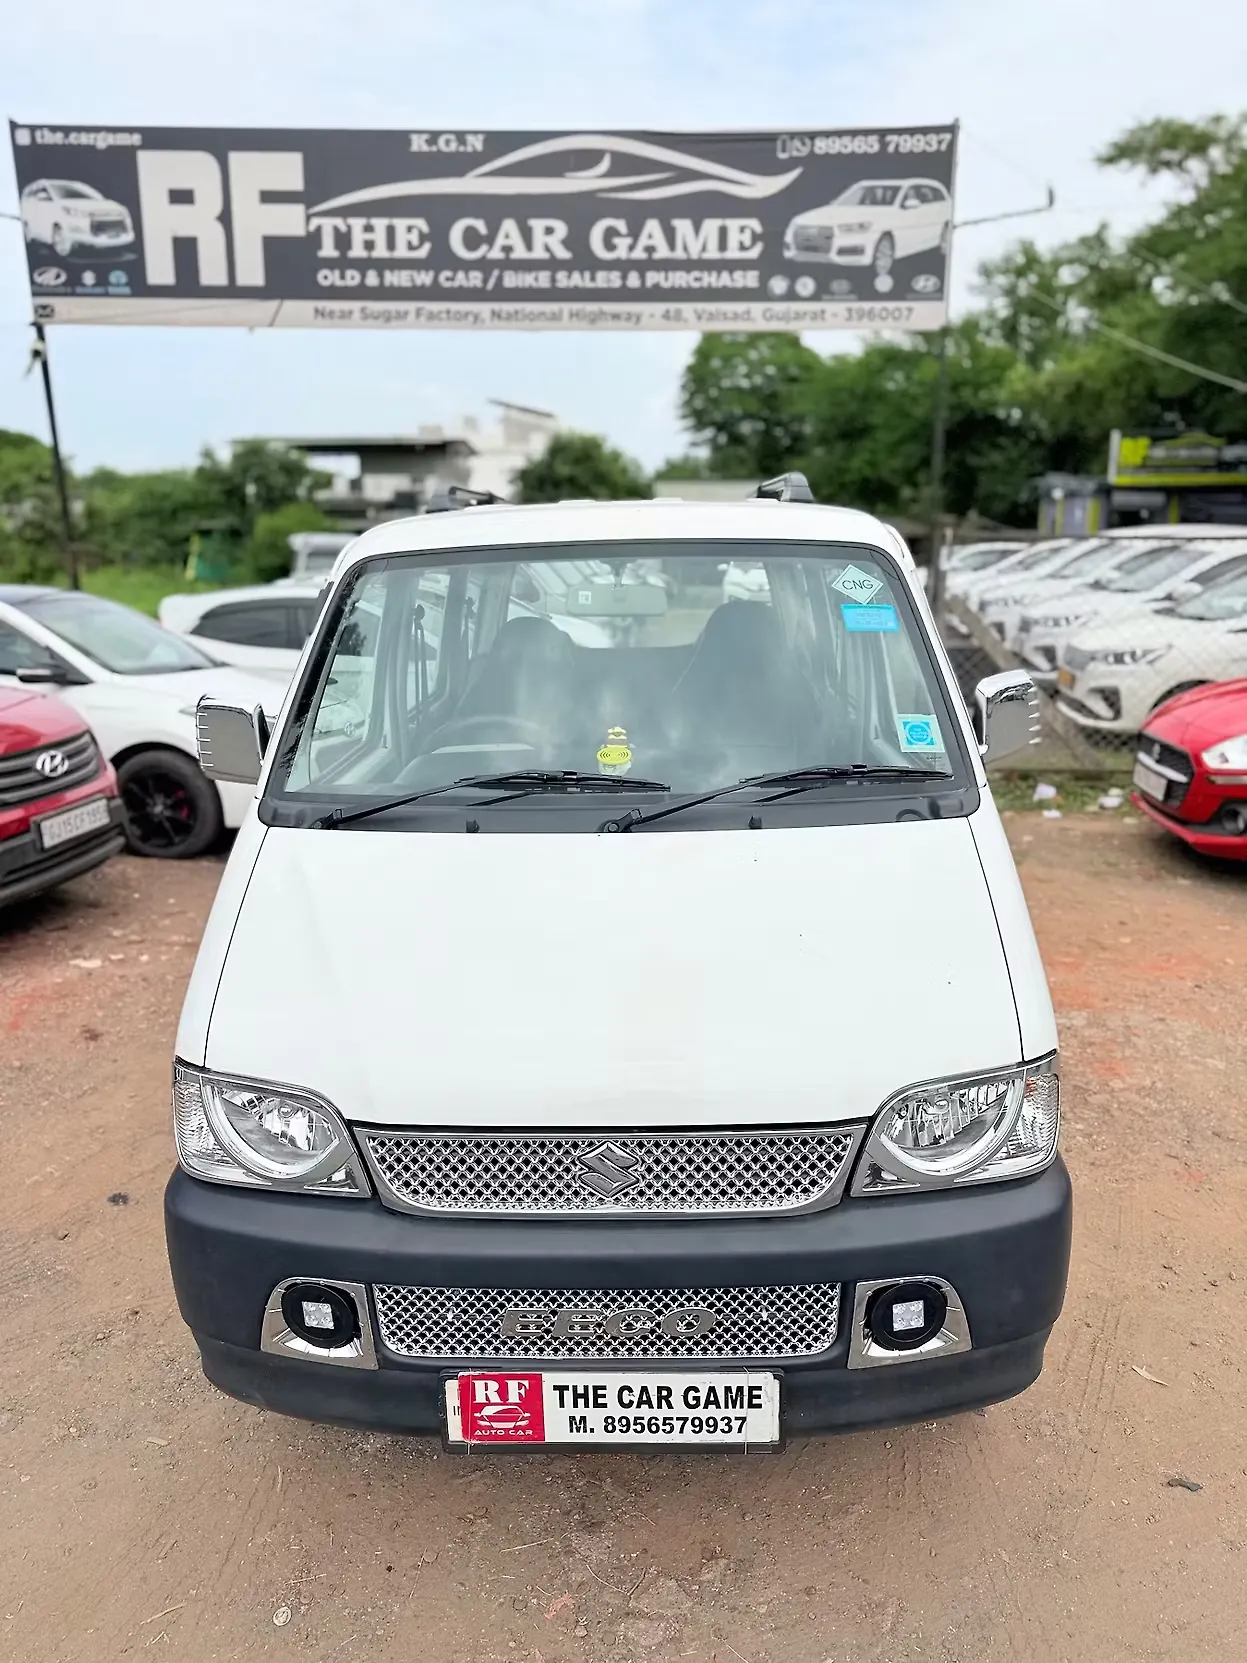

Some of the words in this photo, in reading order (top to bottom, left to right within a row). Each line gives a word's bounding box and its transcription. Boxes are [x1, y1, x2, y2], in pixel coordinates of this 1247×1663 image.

[34, 127, 143, 150] the.cargame
[408, 132, 486, 153] K.G.N
[813, 135, 881, 155] 89565
[885, 132, 953, 154] 79937
[136, 149, 307, 287] RF
[307, 216, 432, 259] THE
[448, 217, 573, 261] CAR
[588, 217, 765, 261] GAME
[316, 268, 362, 288] OLD
[364, 269, 381, 288] &
[383, 269, 435, 288] NEW
[438, 270, 484, 288] CAR
[486, 269, 501, 291] /
[503, 270, 552, 288] BIKE
[555, 270, 623, 289] SALES
[626, 270, 642, 289] &
[645, 270, 761, 289] PURCHASE
[314, 305, 354, 321] Near
[359, 305, 410, 325] Sugar
[415, 306, 487, 326] Factory,
[490, 307, 563, 322] National
[568, 305, 643, 326] Highway
[761, 305, 827, 325] Gujarat
[844, 306, 915, 322] 396007
[841, 579, 875, 591] CNG
[500, 1306, 717, 1338] EECO
[472, 1380, 530, 1404] RF
[552, 1384, 608, 1409] THE
[617, 1385, 674, 1410] CAR
[682, 1385, 763, 1410] GAME
[568, 1415, 595, 1434] M.
[603, 1415, 747, 1435] 8956579937
